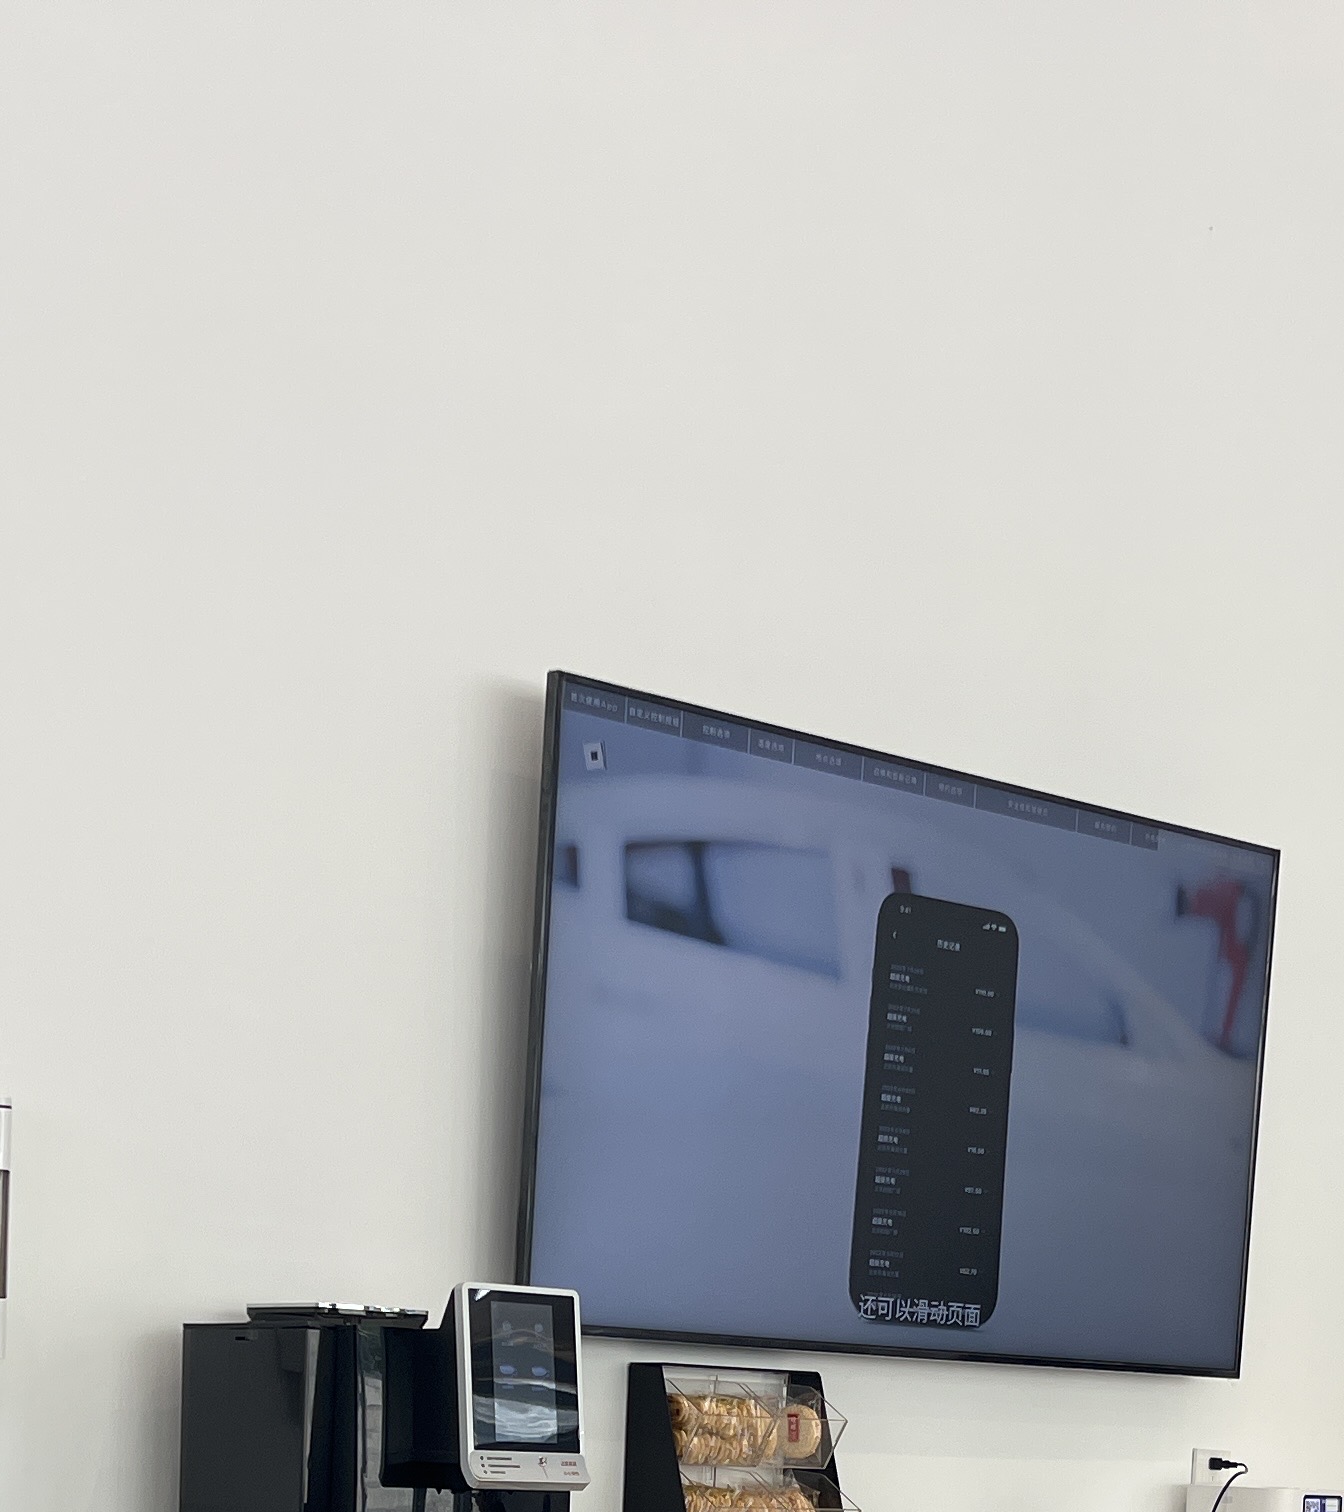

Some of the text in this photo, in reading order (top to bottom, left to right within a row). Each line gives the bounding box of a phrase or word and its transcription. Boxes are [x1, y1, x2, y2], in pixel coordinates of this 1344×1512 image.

[858, 1294, 981, 1327] 还可以滑动页面
